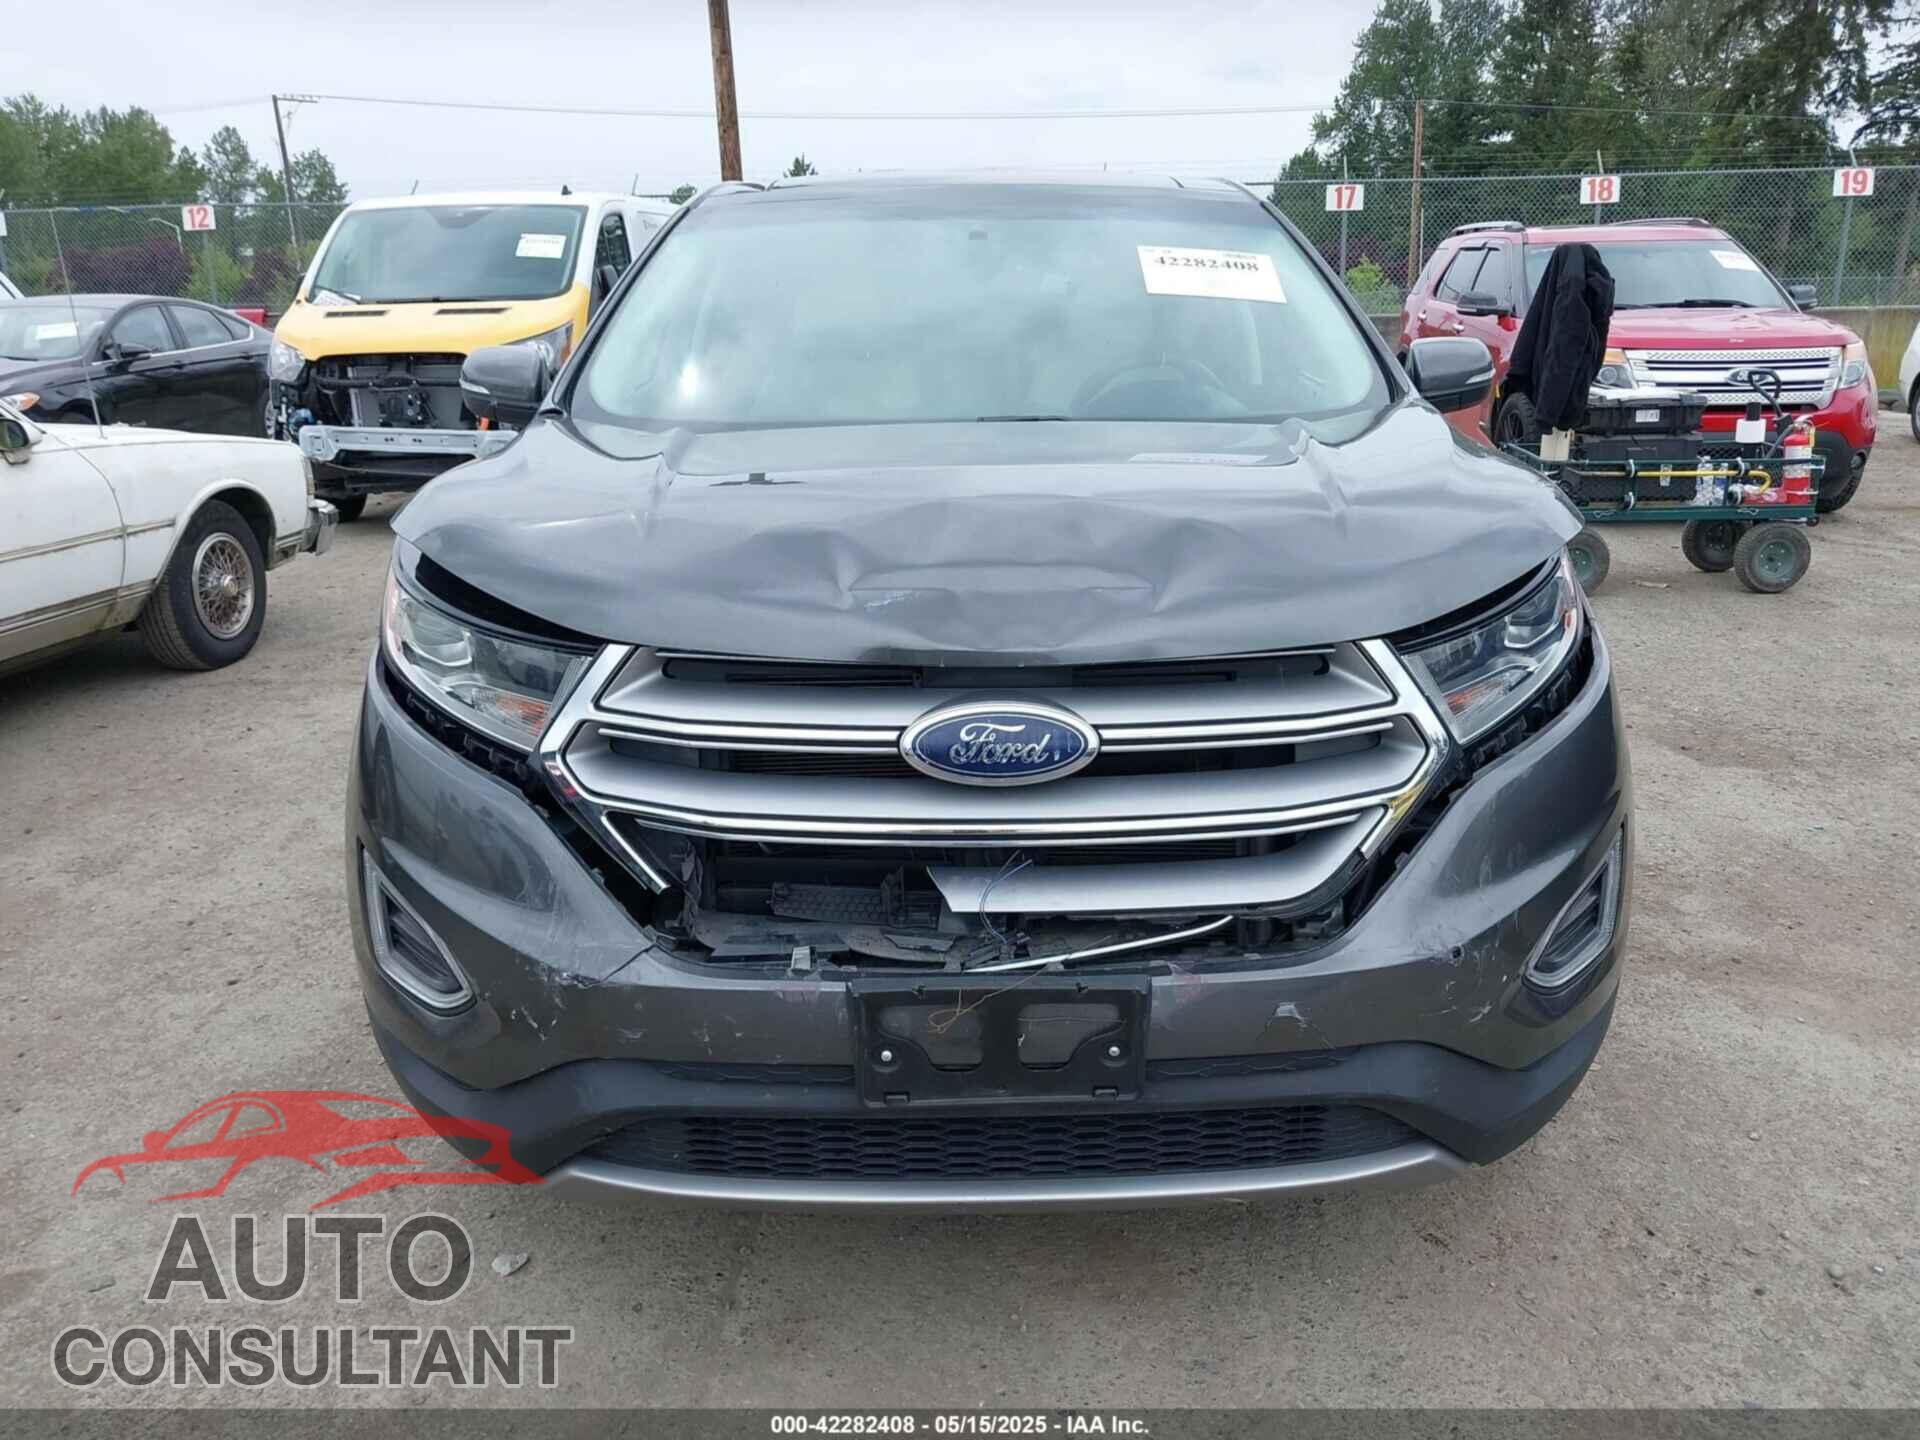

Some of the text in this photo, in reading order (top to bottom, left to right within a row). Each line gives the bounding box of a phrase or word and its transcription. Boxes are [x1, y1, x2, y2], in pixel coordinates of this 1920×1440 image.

[1587, 178, 1613, 202] 18
[1841, 170, 1868, 194] 19
[1334, 186, 1357, 209] 17
[187, 207, 209, 229] 12
[1154, 255, 1260, 273] 42282408
[948, 721, 1053, 766] Ford
